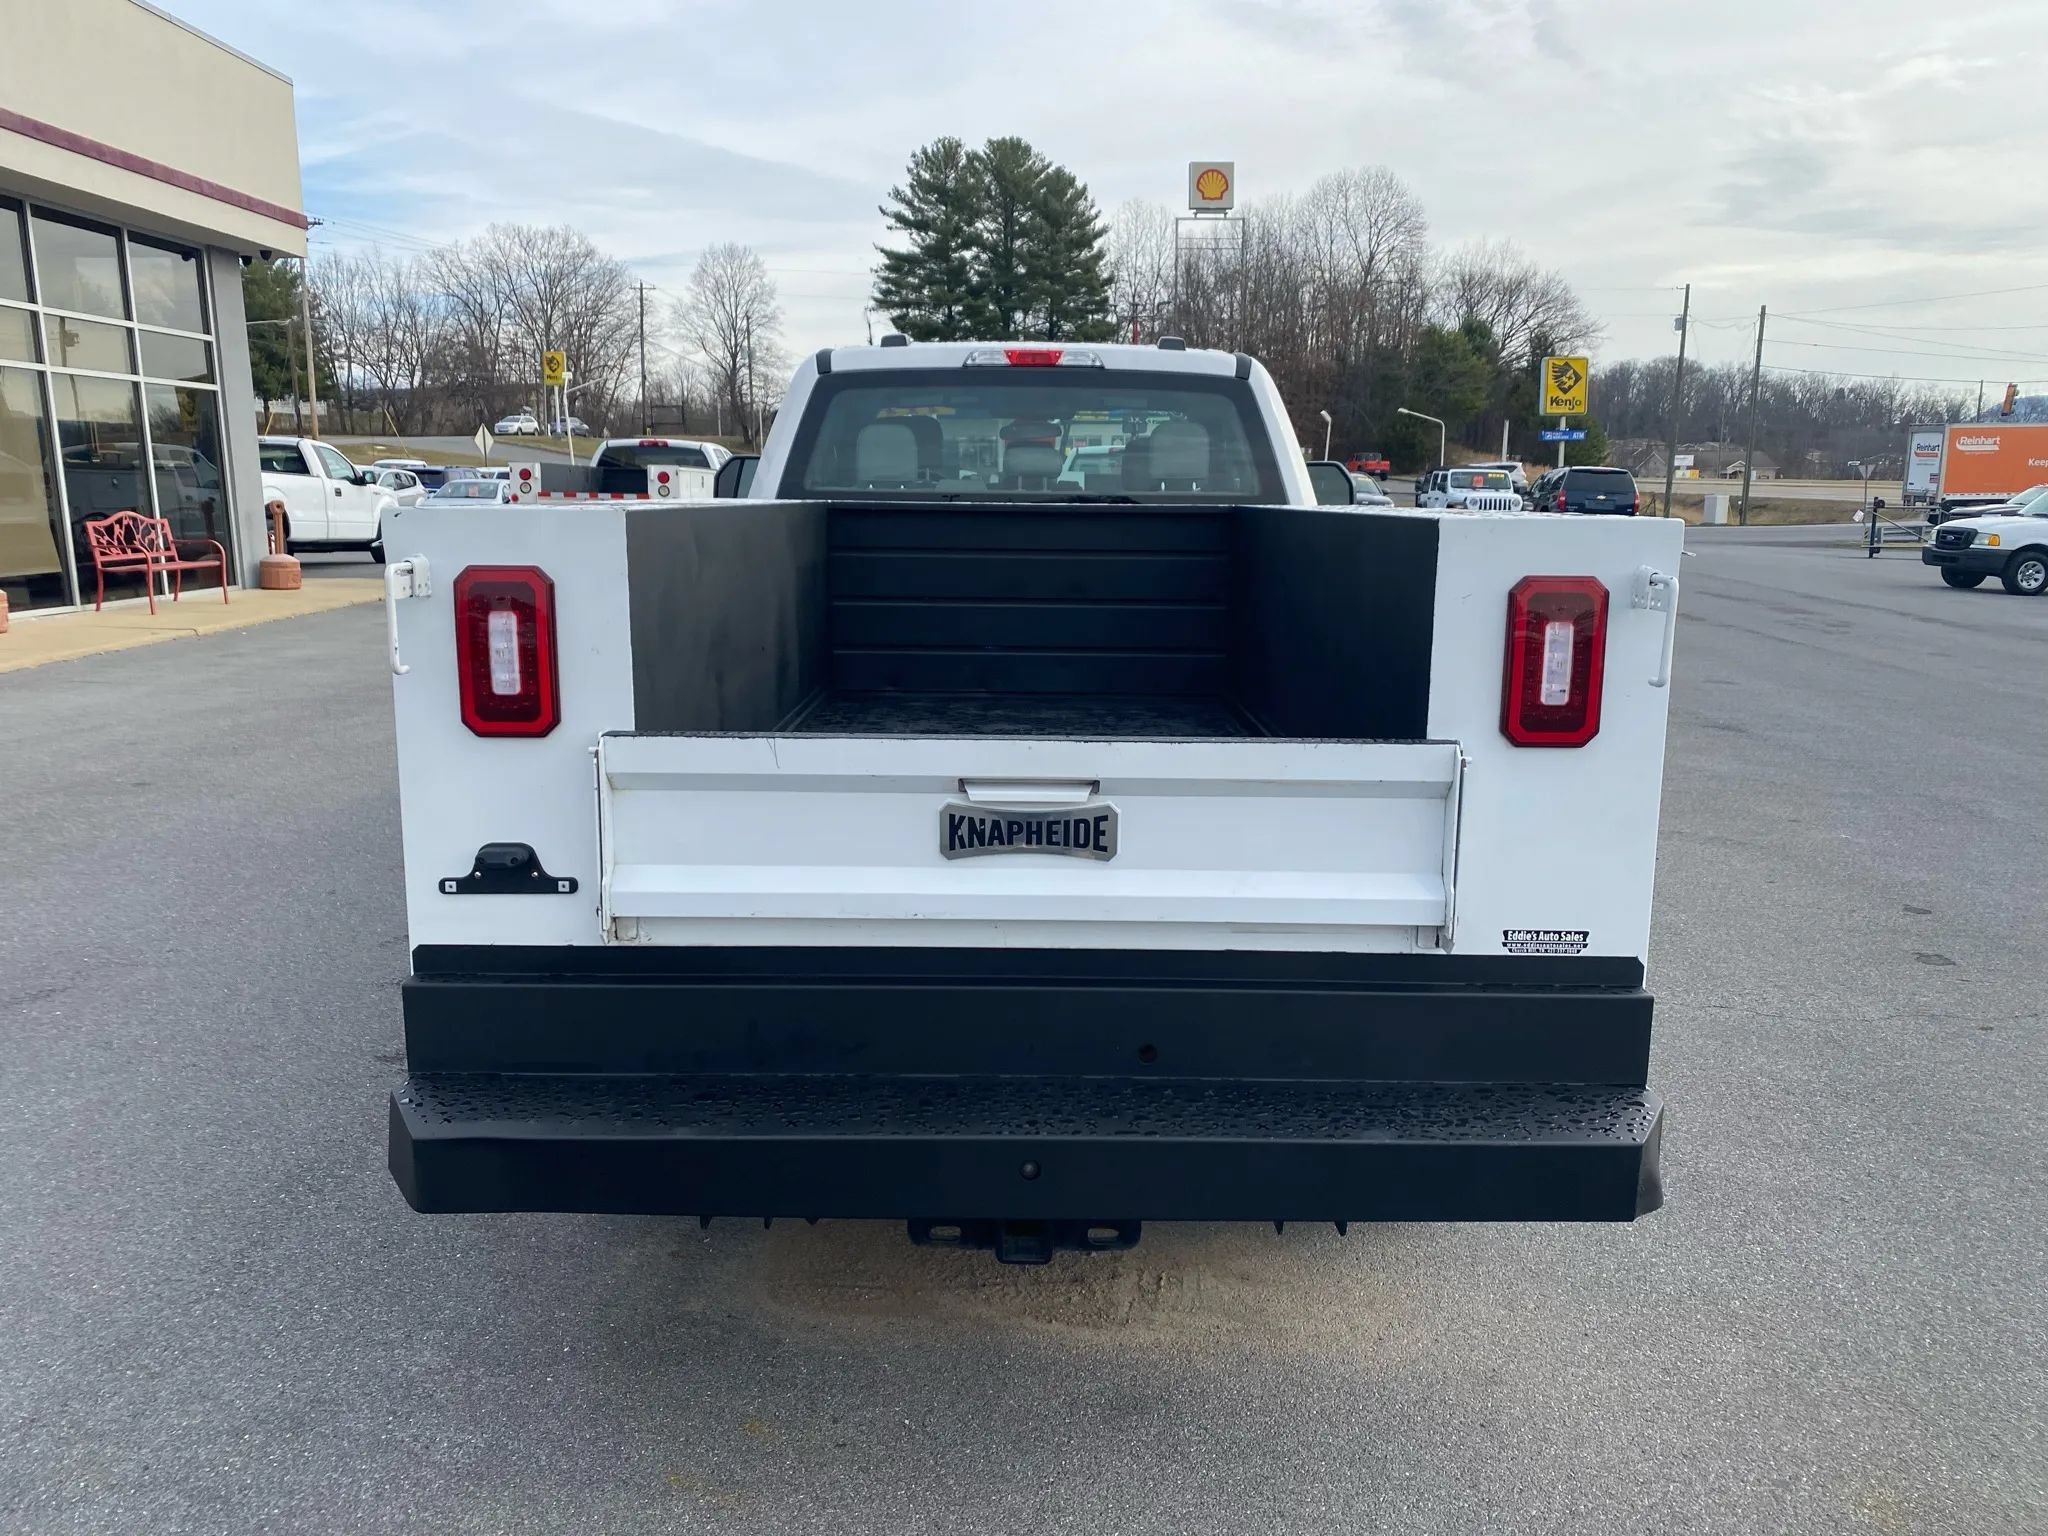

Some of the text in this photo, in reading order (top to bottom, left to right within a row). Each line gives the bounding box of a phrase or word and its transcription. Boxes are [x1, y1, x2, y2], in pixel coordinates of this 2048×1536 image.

[1550, 396, 1582, 411] Kenjo
[1959, 435, 2001, 445] Reinhart
[1916, 443, 1940, 452] Reinhart
[948, 813, 1109, 853] KNAPHEIDE
[1507, 930, 1584, 942] Eddie's Auto Sales
